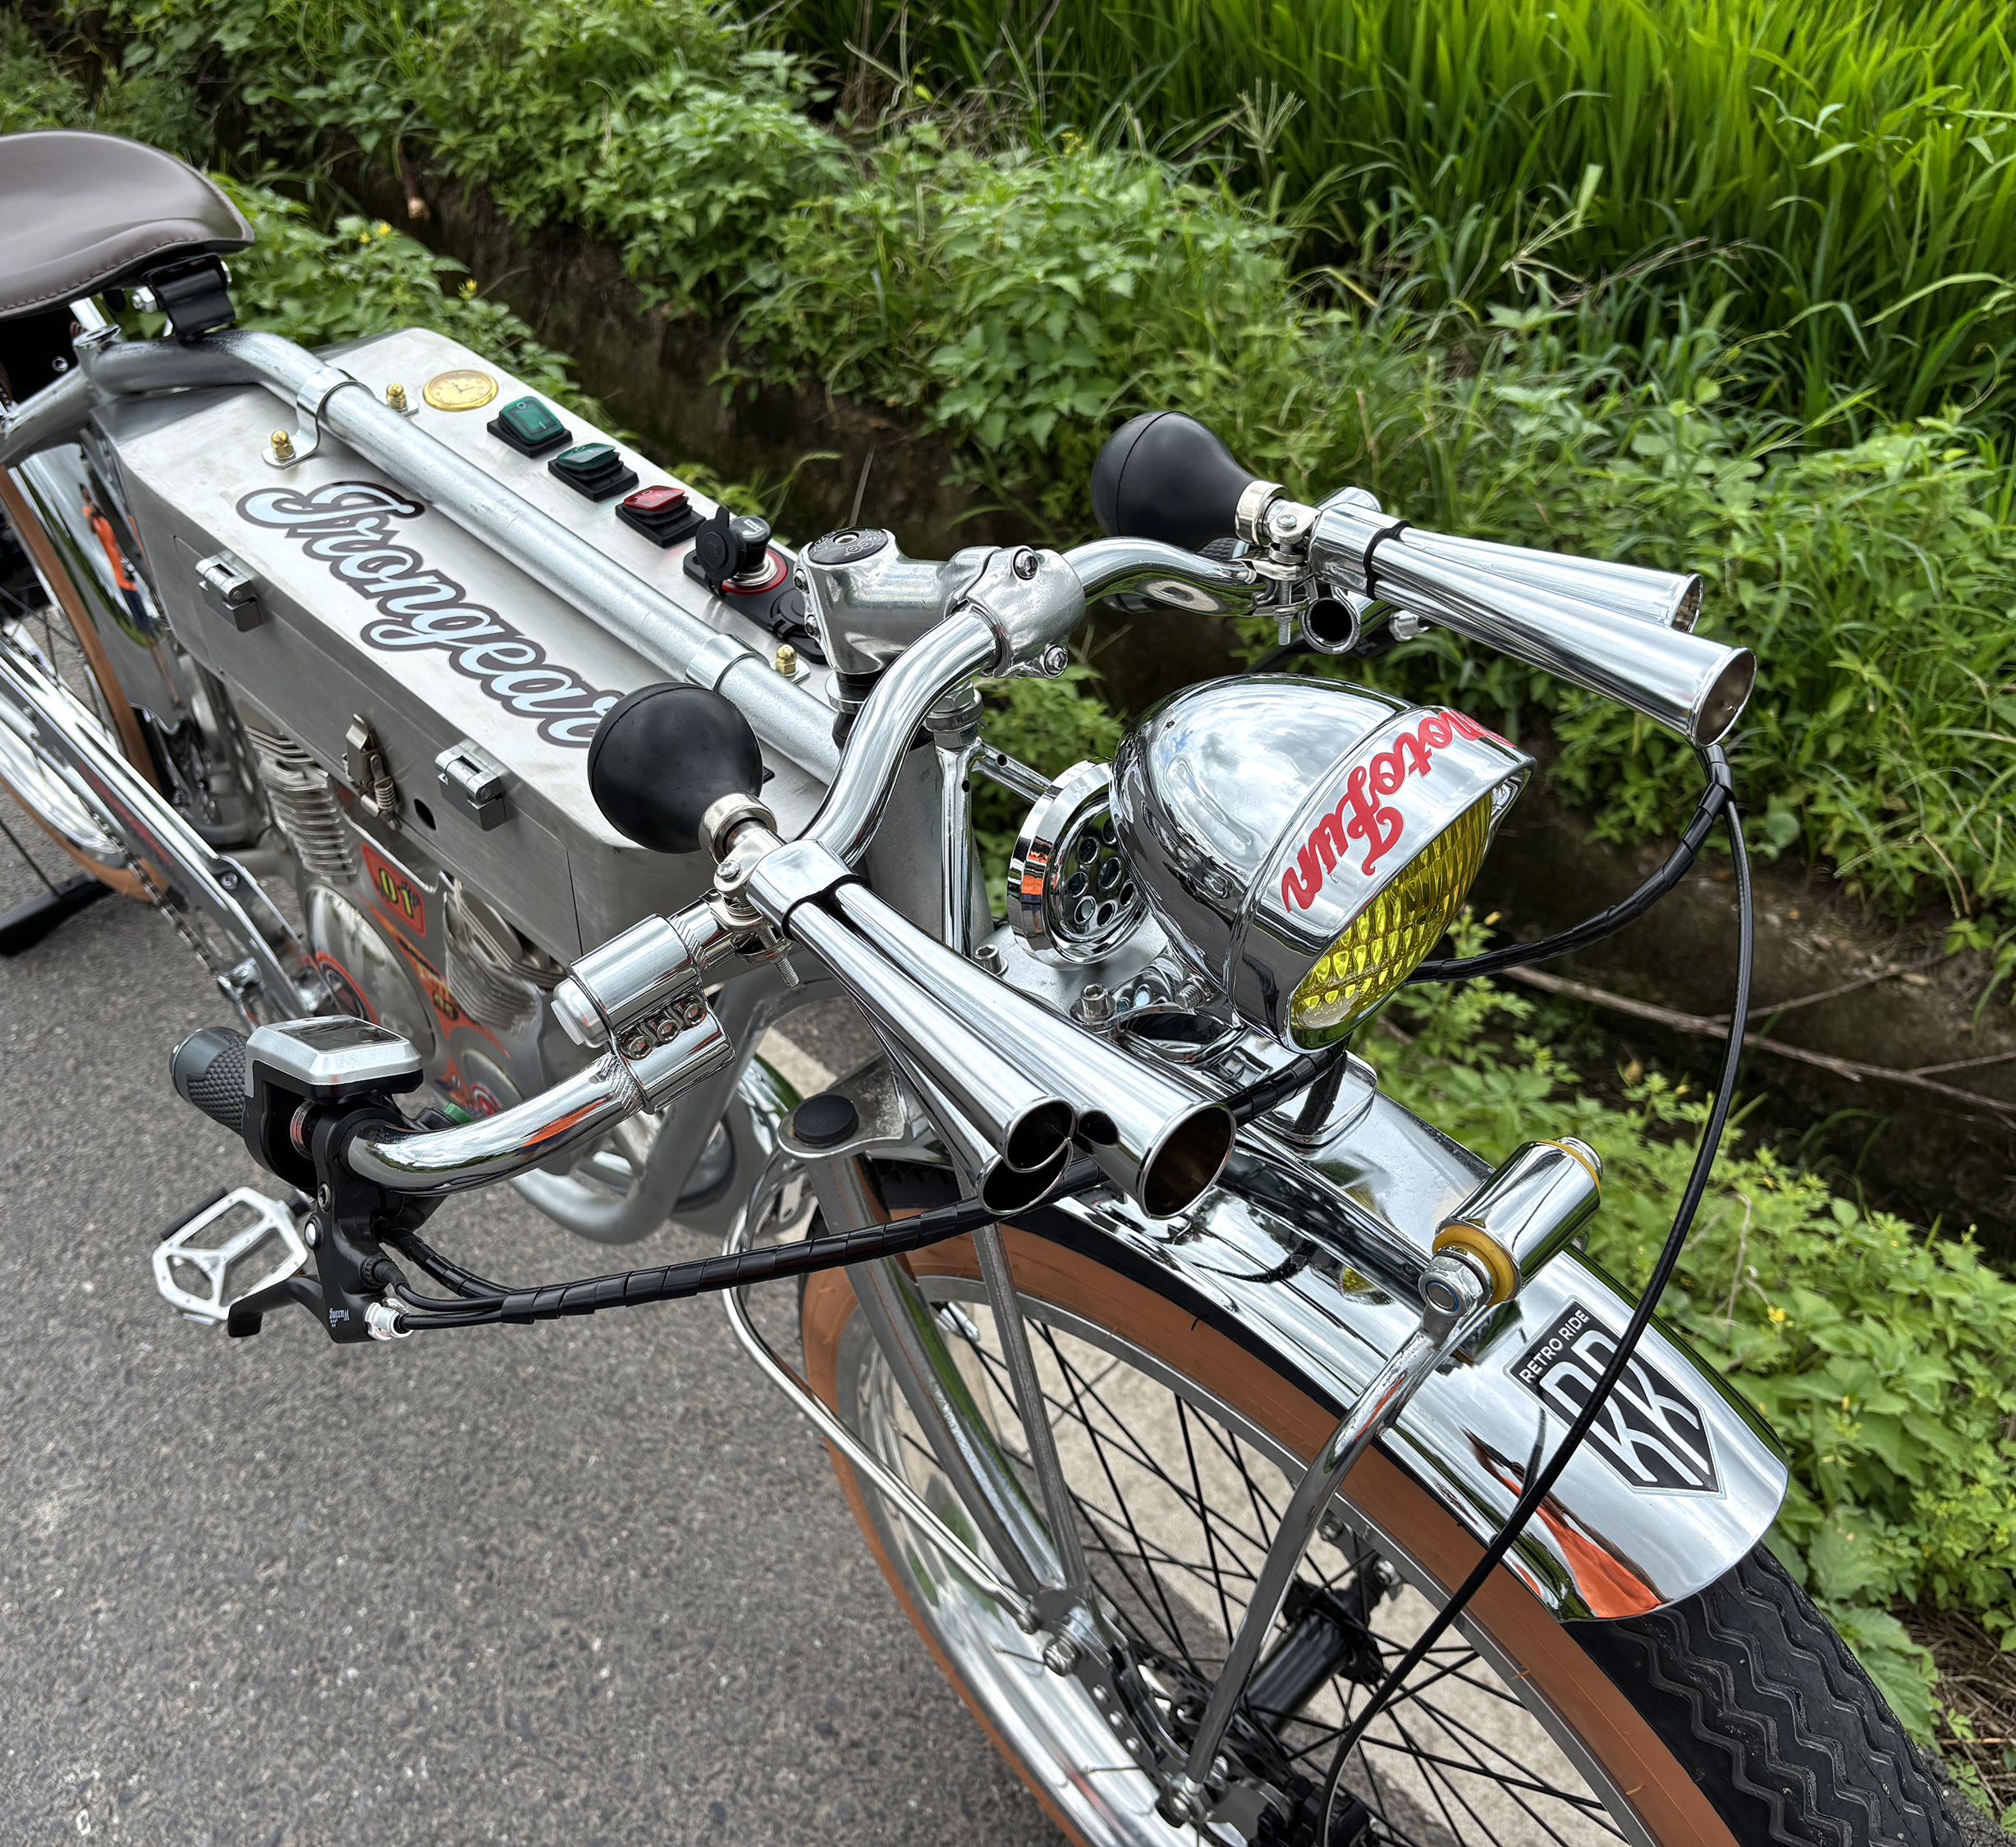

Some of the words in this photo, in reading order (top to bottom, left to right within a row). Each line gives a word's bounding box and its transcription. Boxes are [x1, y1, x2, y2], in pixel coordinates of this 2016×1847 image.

[379, 868, 414, 919] 01
[1519, 1337, 1564, 1384] RETRO
[1558, 1309, 1591, 1341] RIDE
